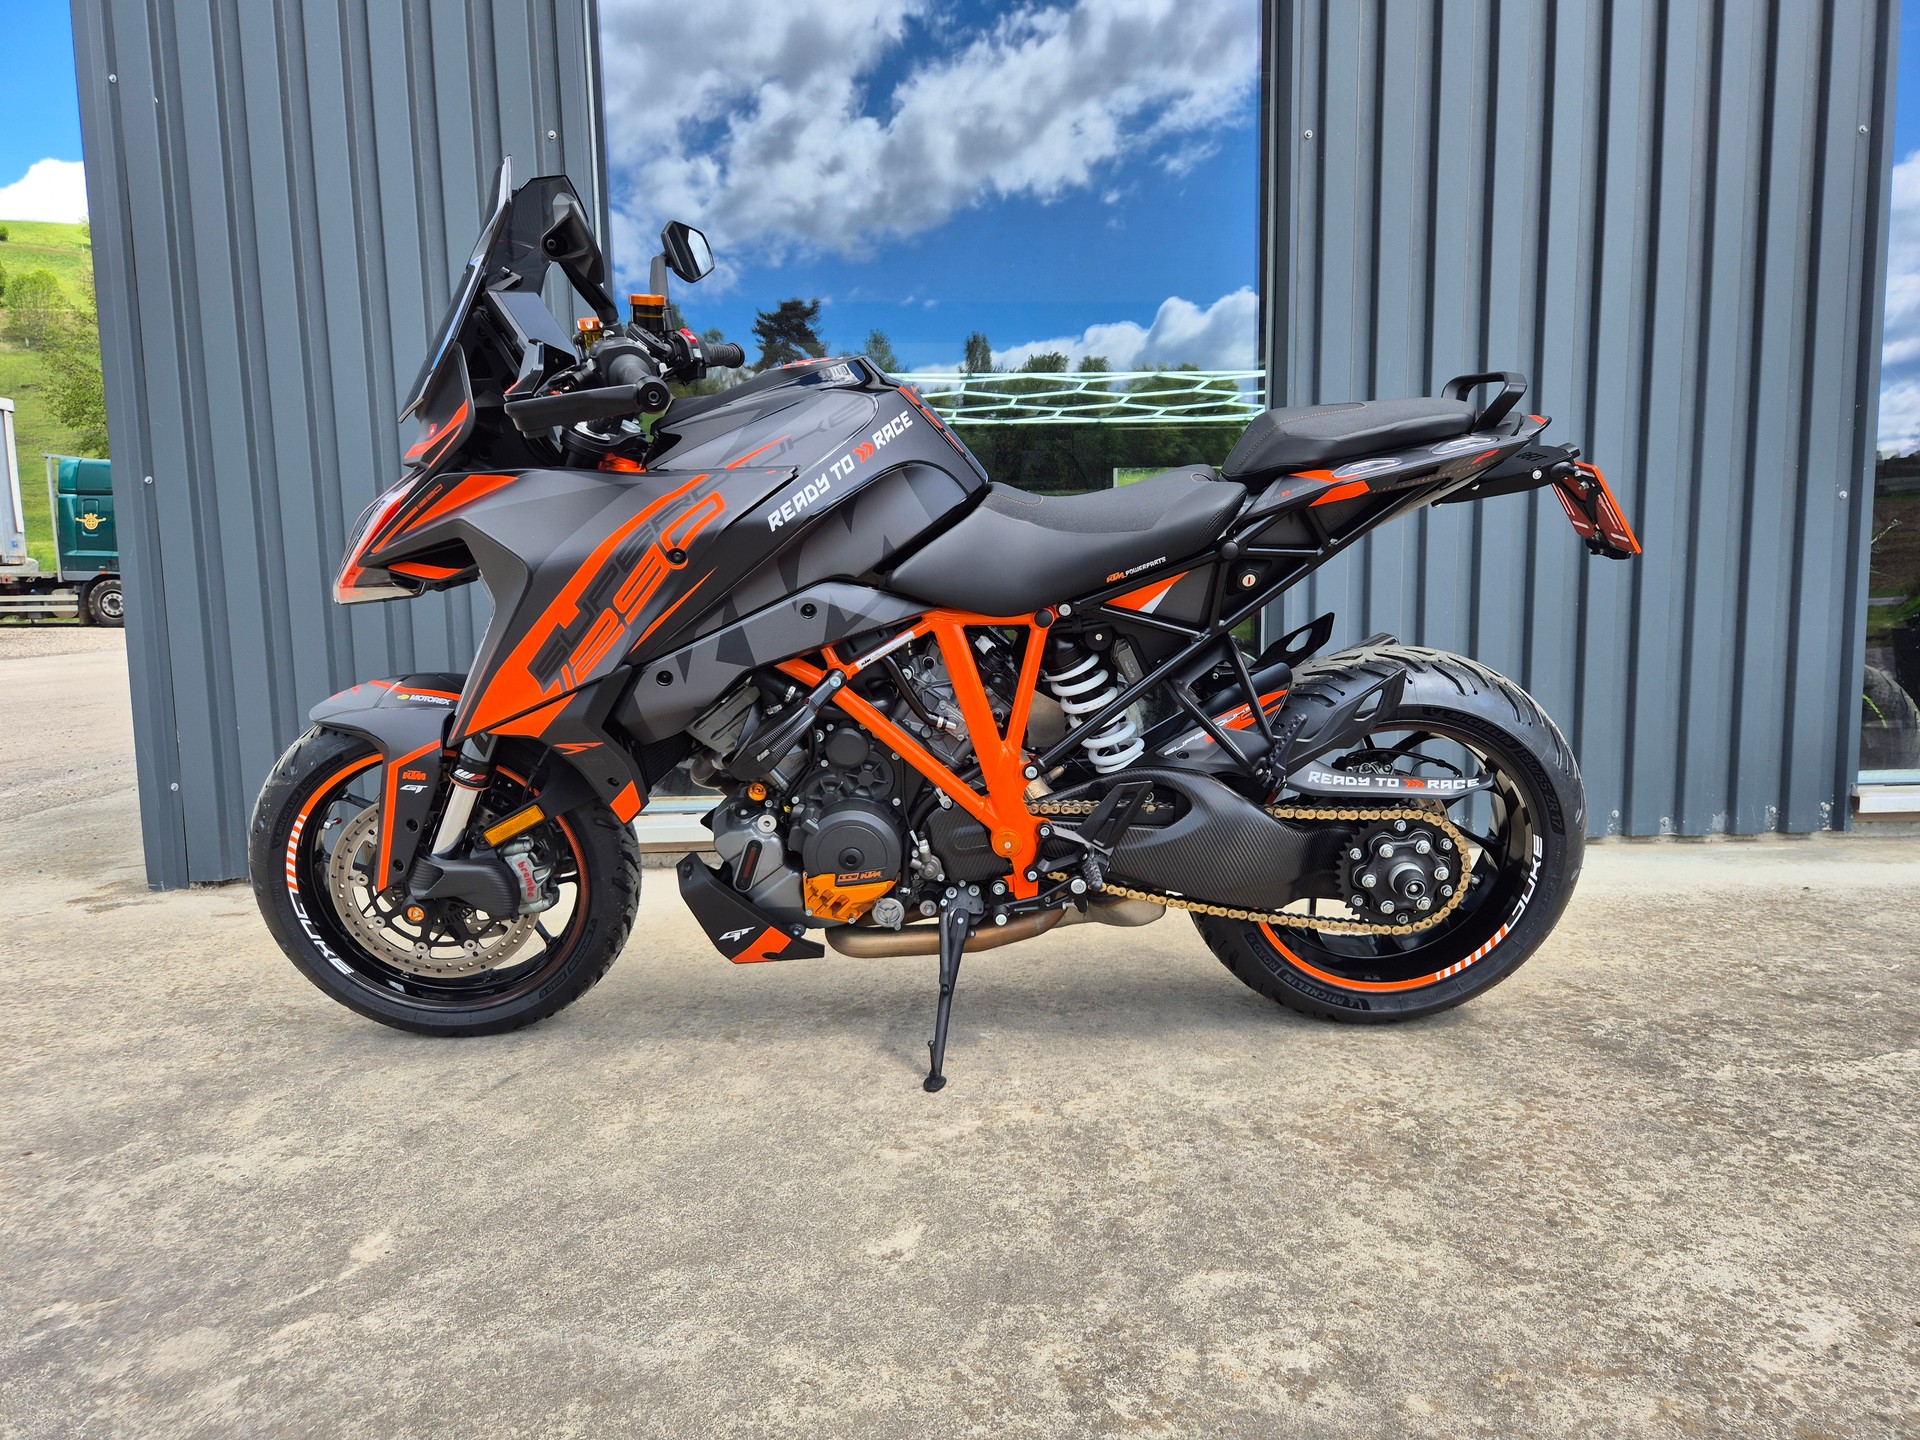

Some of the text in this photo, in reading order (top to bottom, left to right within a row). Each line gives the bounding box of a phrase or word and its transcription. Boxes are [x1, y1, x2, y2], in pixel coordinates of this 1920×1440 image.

[767, 410, 913, 533] READY TO RACE
[1106, 556, 1167, 583] KTM POWERPARTS
[410, 695, 452, 706] MOTOREX
[1164, 730, 1208, 756] SUPE
[402, 770, 427, 781] KTM
[1307, 771, 1480, 790] READY TO RACE
[1450, 710, 1516, 750] MICHELIN
[1516, 750, 1549, 790] 190/55
[1551, 815, 1564, 829] 17
[400, 785, 429, 794] GT
[517, 861, 537, 898] brembo
[1505, 833, 1543, 932] DUKE
[289, 888, 355, 975] DUKE
[719, 926, 756, 942] GT
[1253, 943, 1280, 972] ROAD
[1283, 972, 1346, 1007] MICHELIN
